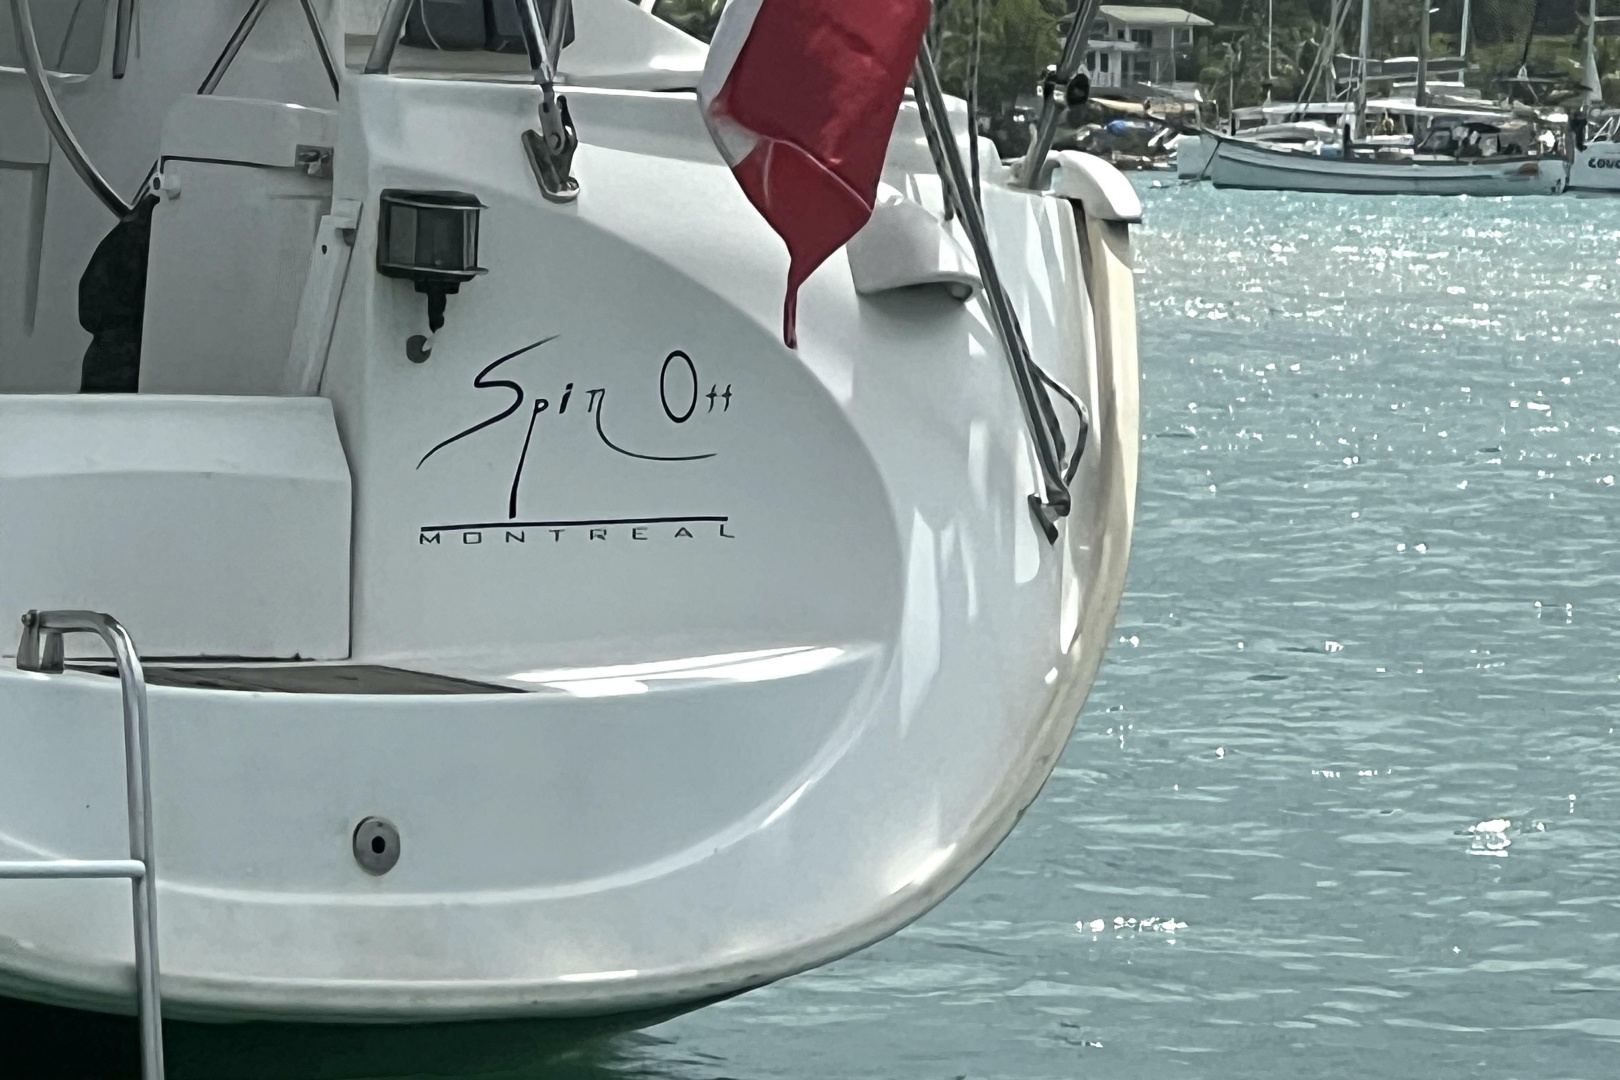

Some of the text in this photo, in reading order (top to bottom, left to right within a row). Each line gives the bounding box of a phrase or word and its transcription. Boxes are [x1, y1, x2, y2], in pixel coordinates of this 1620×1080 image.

[416, 334, 733, 519] Spin Off
[419, 524, 735, 545] MONTREAL
